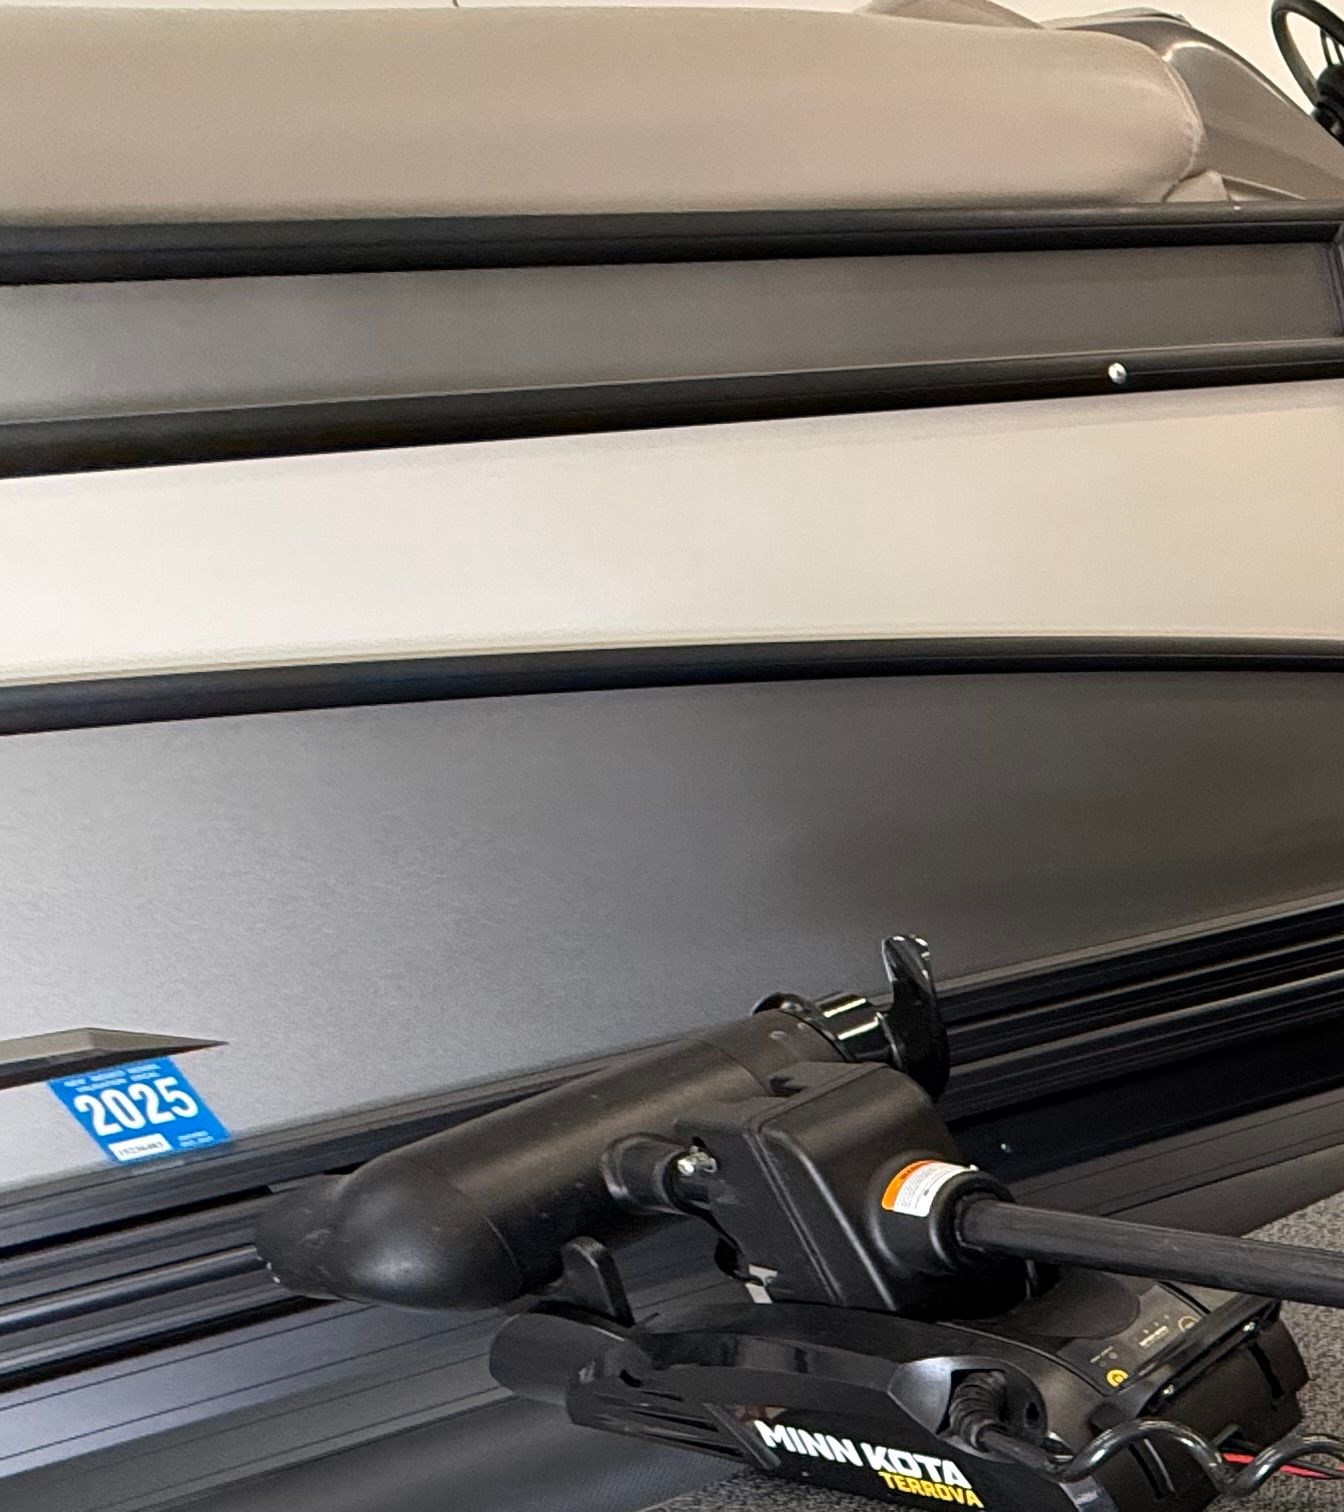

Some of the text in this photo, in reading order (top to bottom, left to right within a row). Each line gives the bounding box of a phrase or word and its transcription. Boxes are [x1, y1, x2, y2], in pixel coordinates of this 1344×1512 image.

[73, 1076, 198, 1137] 2025
[754, 1420, 972, 1489] MINN KOTA
[878, 1471, 984, 1508] TERROVA
